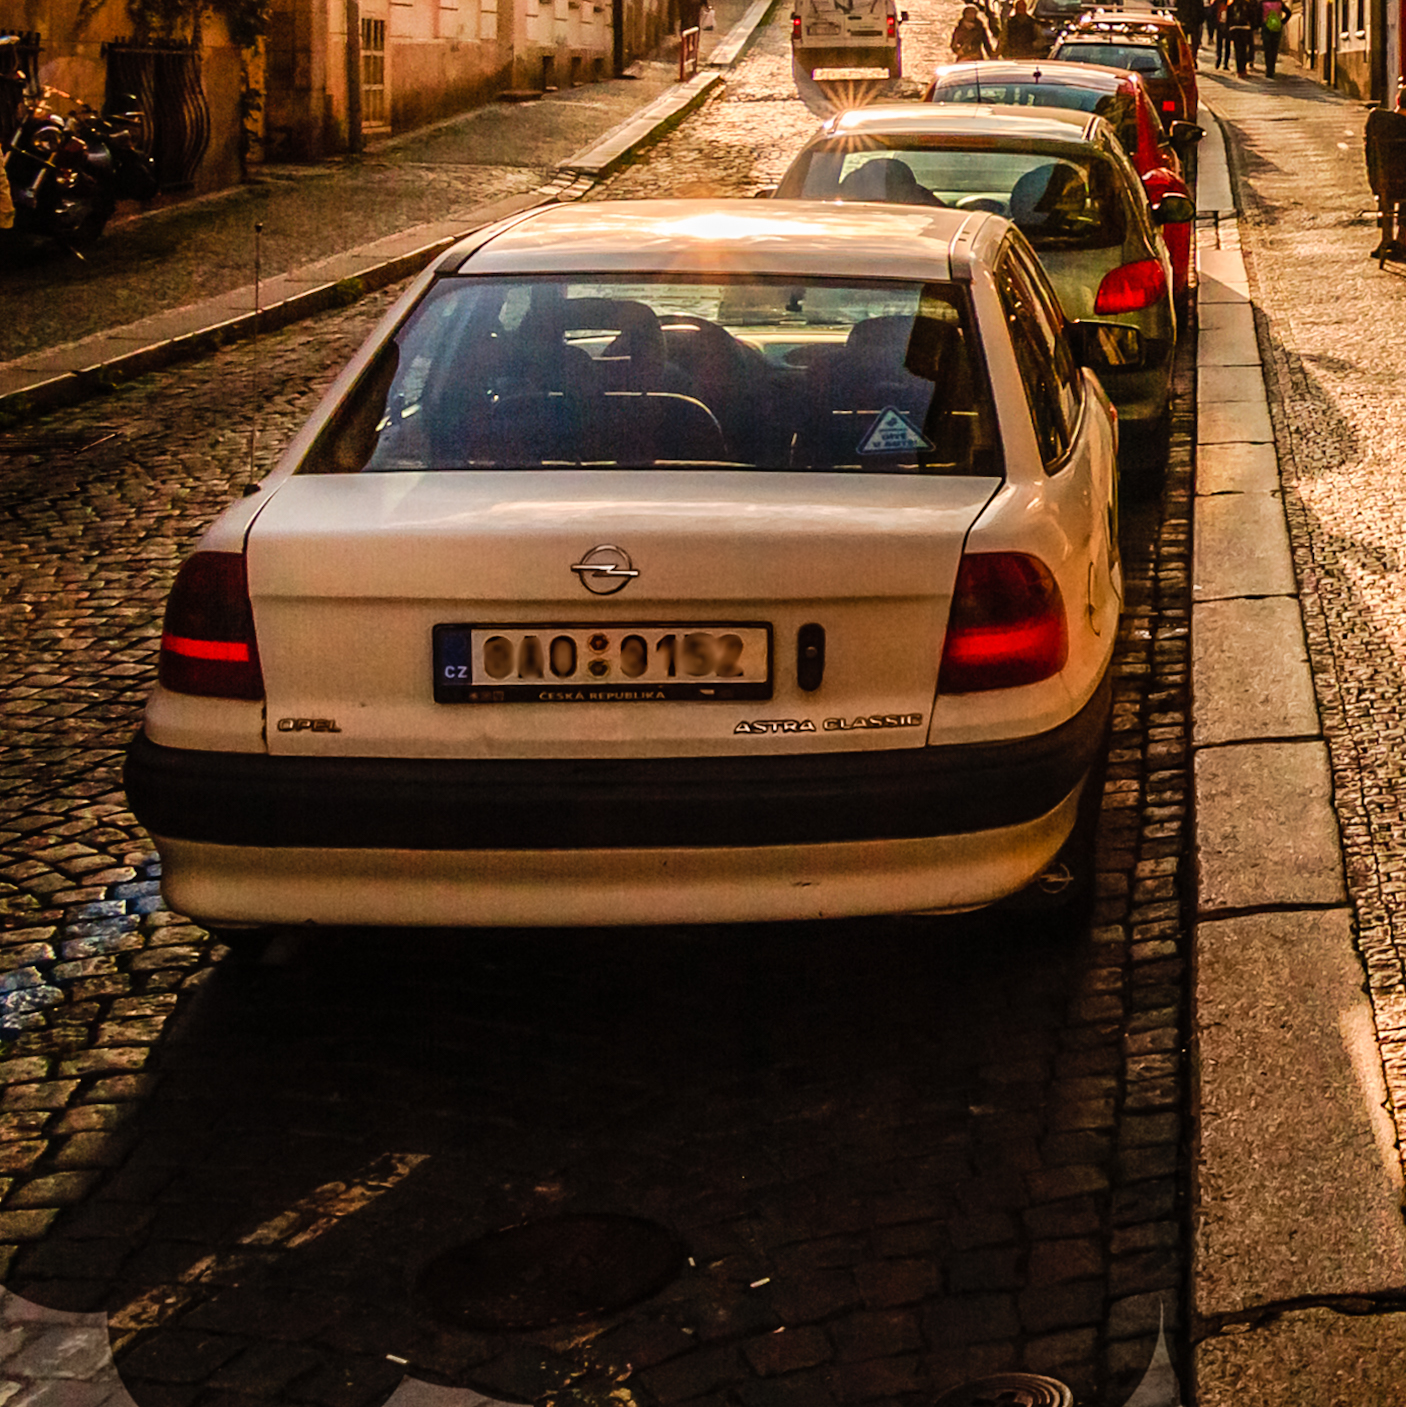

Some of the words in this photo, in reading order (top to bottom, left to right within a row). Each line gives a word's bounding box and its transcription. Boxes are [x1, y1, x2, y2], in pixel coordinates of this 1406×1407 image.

[444, 665, 468, 679] CZ
[539, 689, 585, 700] ČESKÁ
[590, 690, 666, 700] REPUBLIKA
[278, 718, 342, 733] OPEL
[733, 719, 817, 735] ASTRA
[823, 713, 923, 732] CLASSIC
